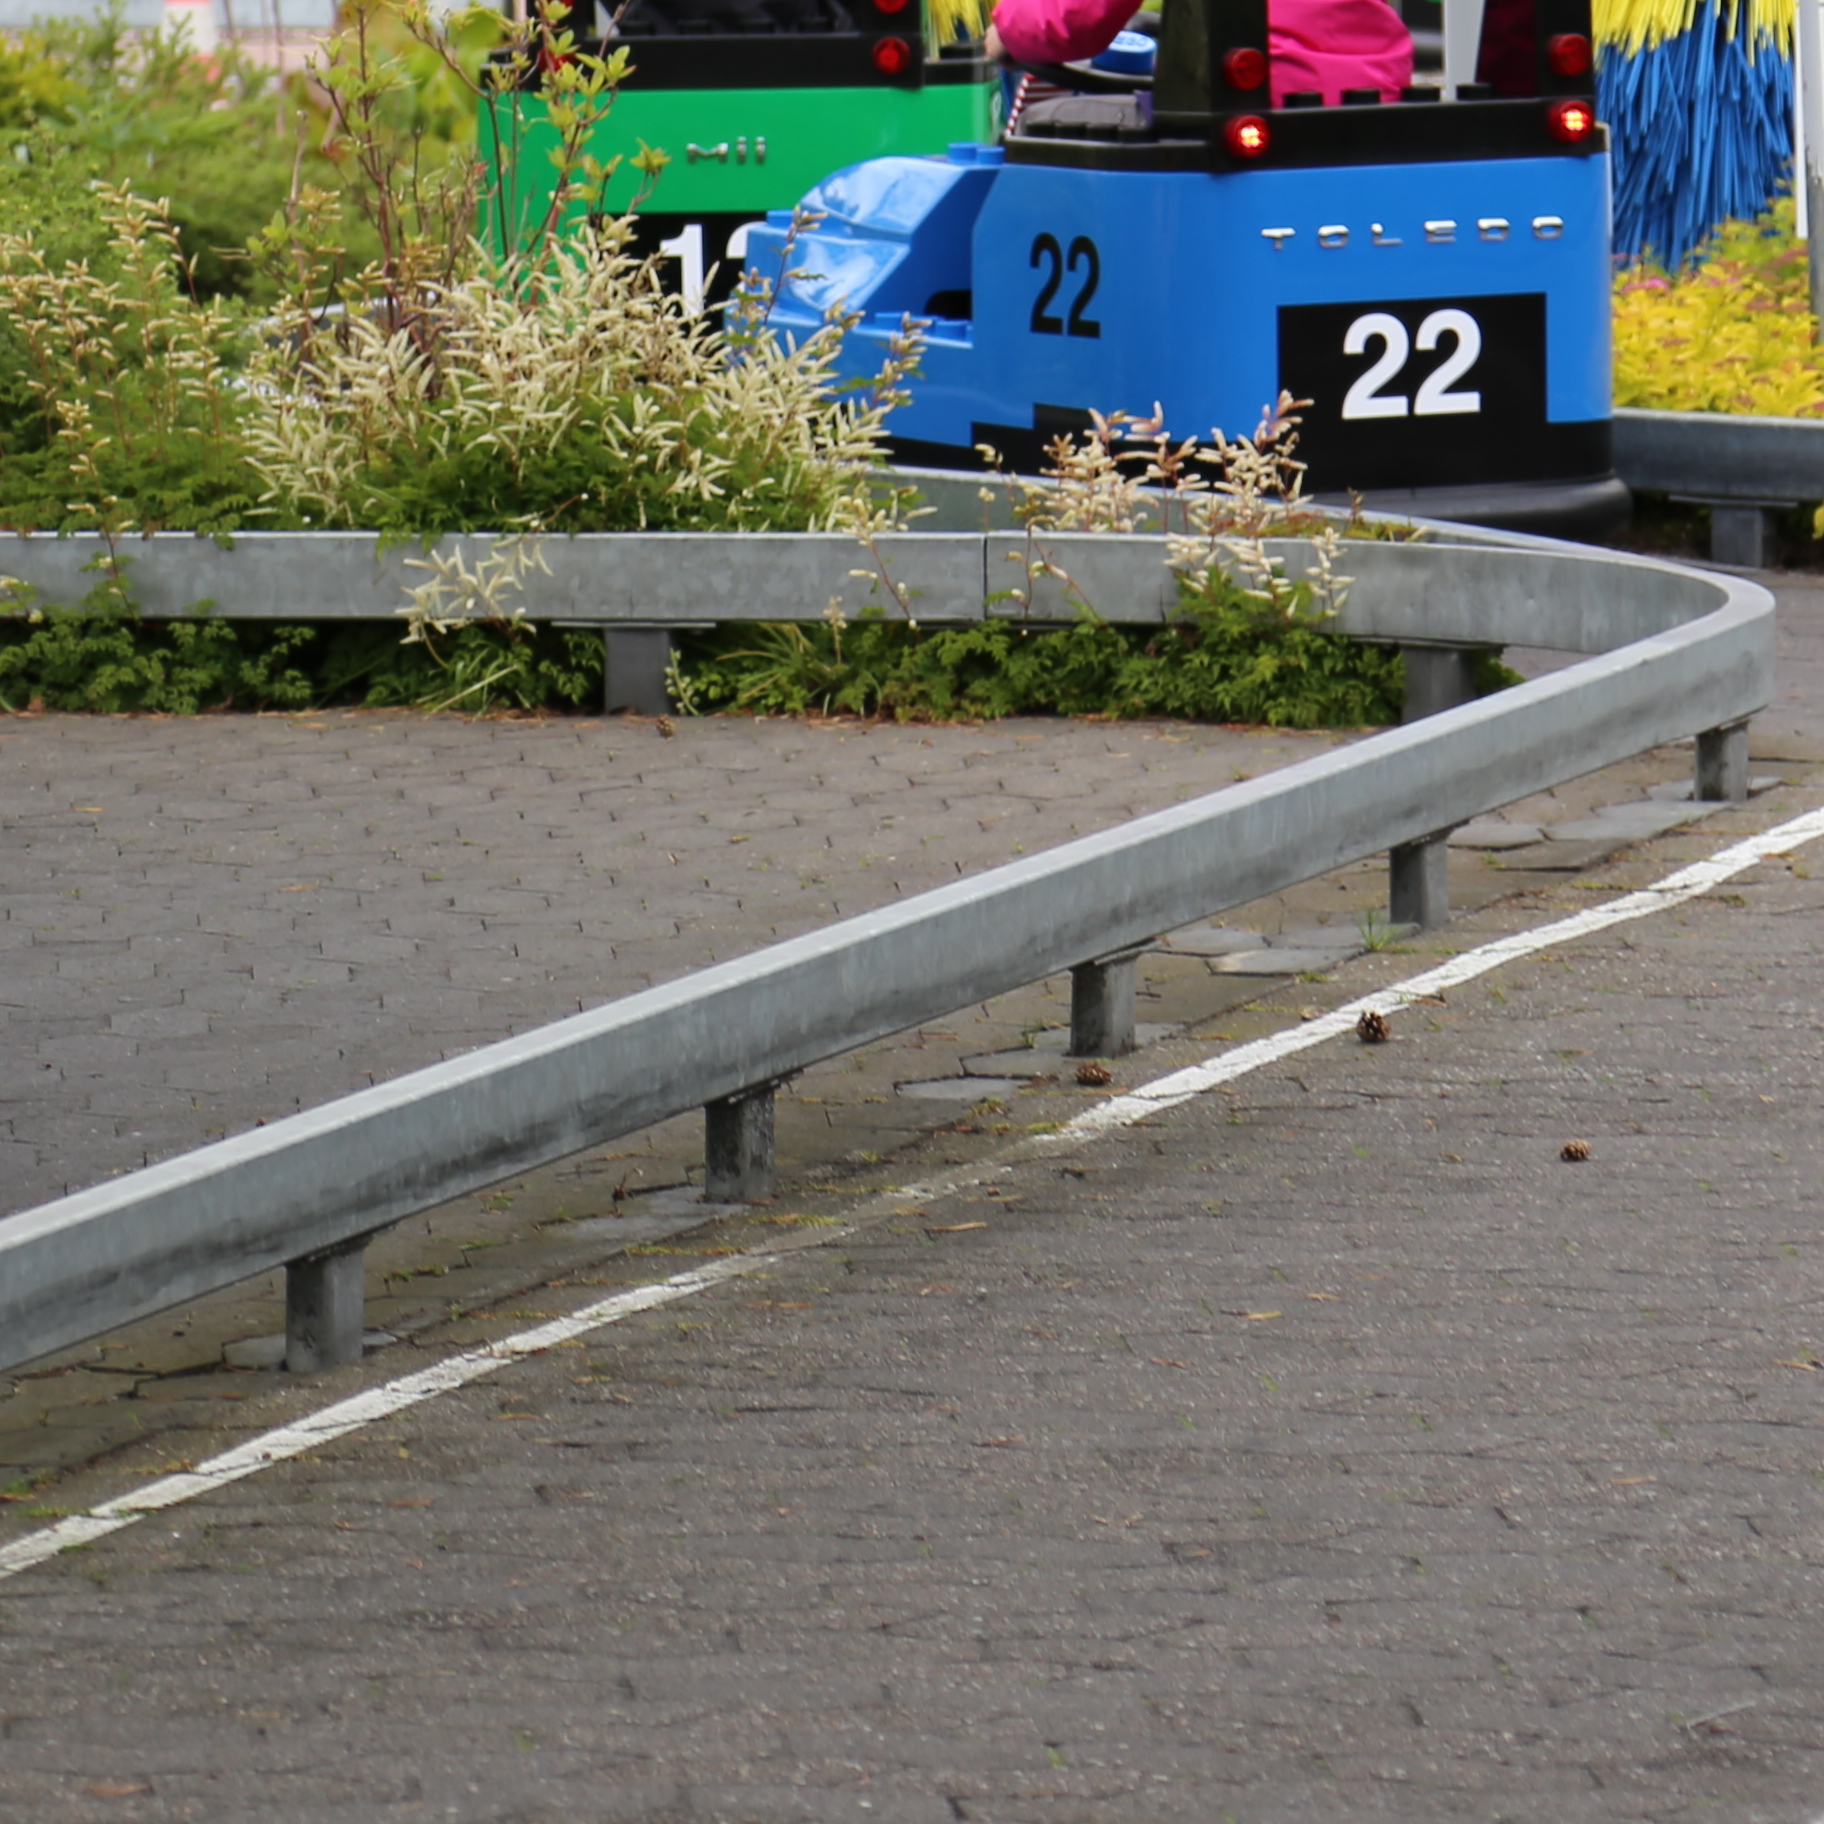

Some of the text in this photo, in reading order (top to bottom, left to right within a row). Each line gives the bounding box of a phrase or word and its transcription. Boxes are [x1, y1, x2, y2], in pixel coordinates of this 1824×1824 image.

[1028, 231, 1102, 339] 22
[1263, 214, 1566, 250] TOLEDO
[1342, 308, 1483, 421] 22
